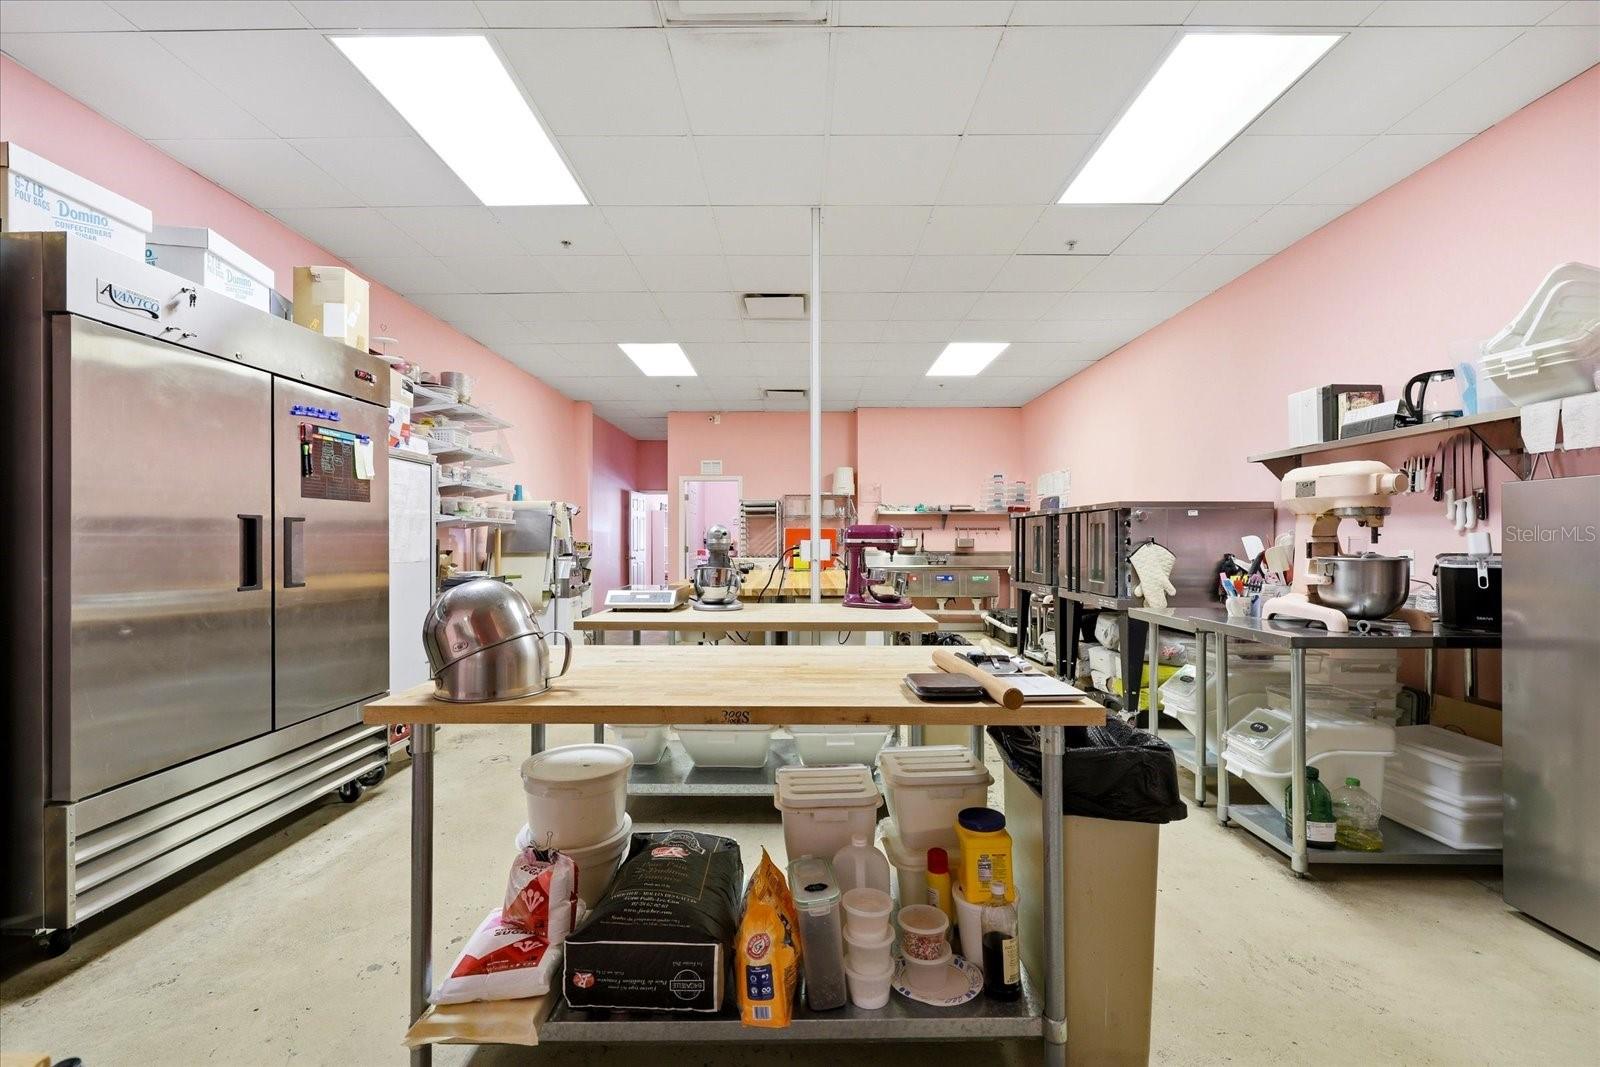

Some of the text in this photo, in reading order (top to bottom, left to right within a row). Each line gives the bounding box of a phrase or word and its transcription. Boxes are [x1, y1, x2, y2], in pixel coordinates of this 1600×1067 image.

[14, 189, 51, 212] POLY BAGS
[32, 182, 44, 198] LB
[57, 199, 109, 227] Domino
[100, 283, 160, 319] AVANTCO
